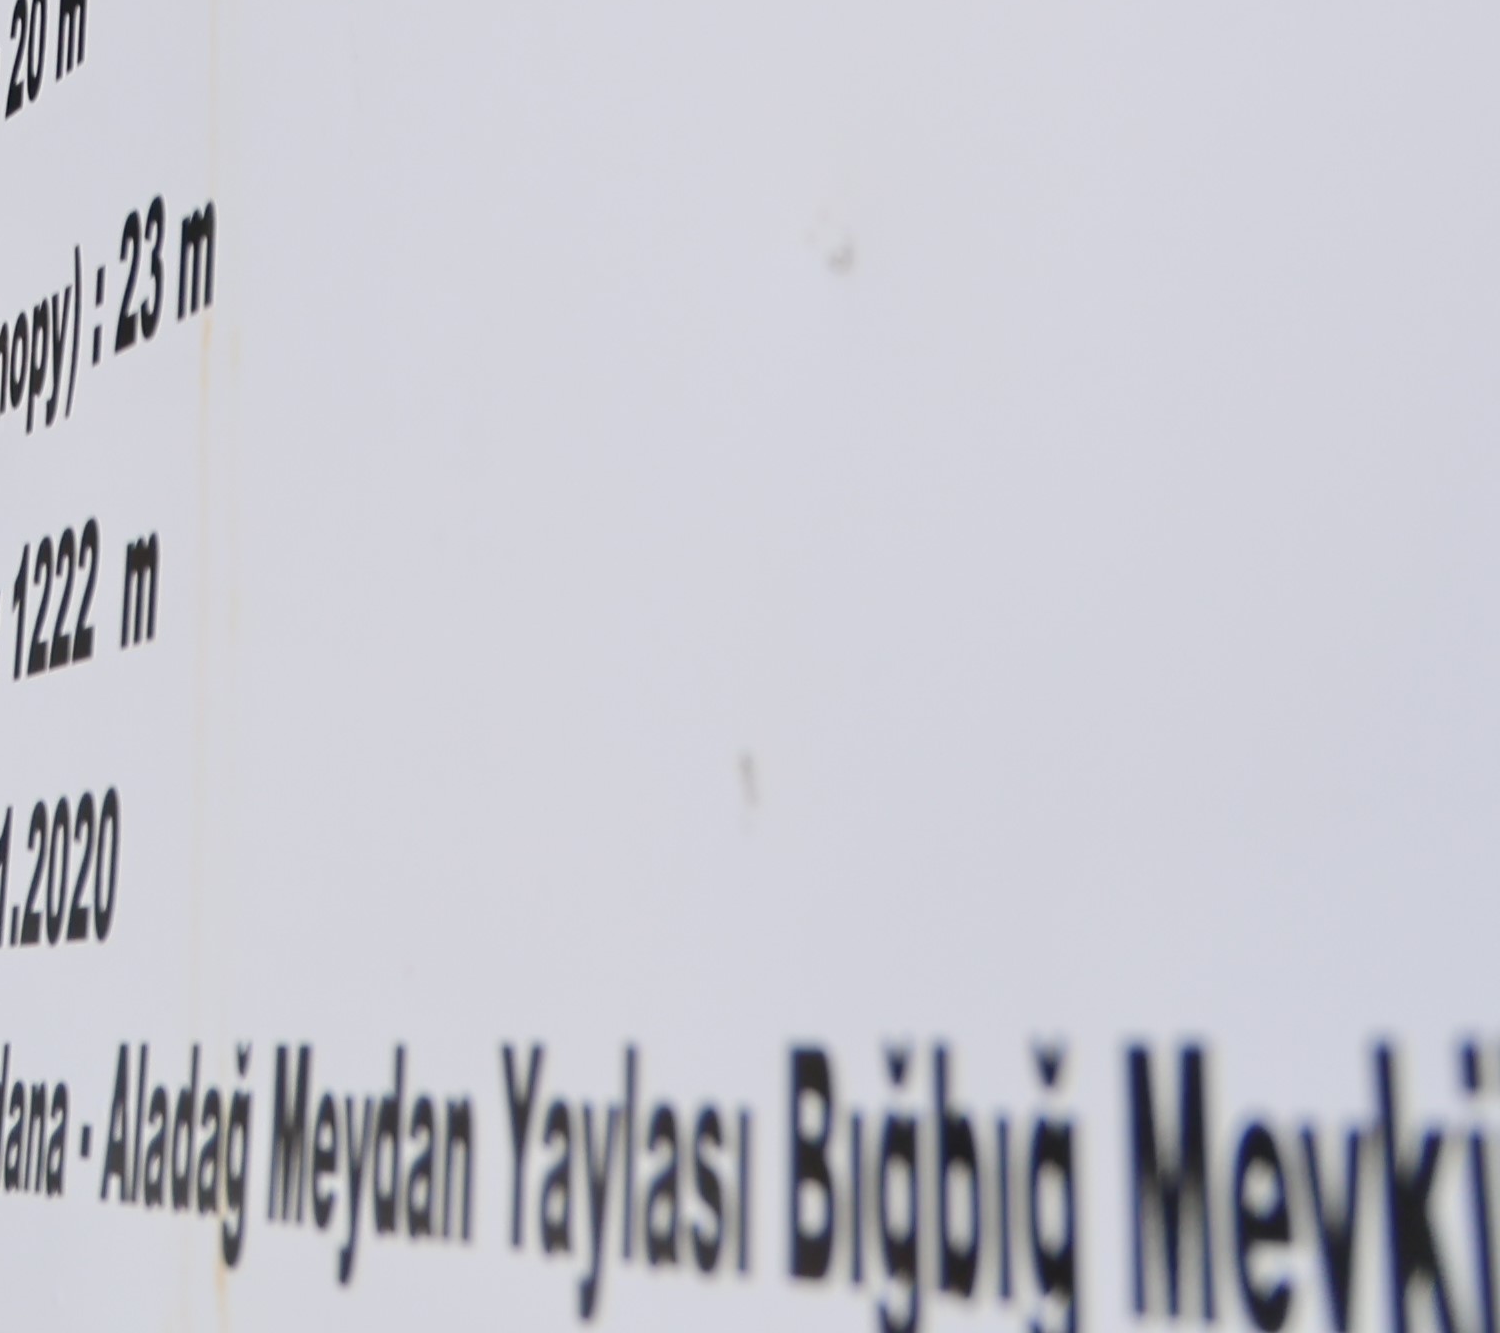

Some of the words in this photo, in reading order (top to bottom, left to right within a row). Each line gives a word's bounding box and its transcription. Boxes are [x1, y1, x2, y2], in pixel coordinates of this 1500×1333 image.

[114, 193, 167, 355] 23
[178, 198, 218, 324] m
[11, 516, 102, 683] 1222
[119, 528, 162, 651] m
[99, 1040, 255, 1271] Aladağ
[265, 1042, 475, 1289] Meydan
[499, 1039, 750, 1323] Yaylası
[1122, 1031, 1500, 1333] Mevki
